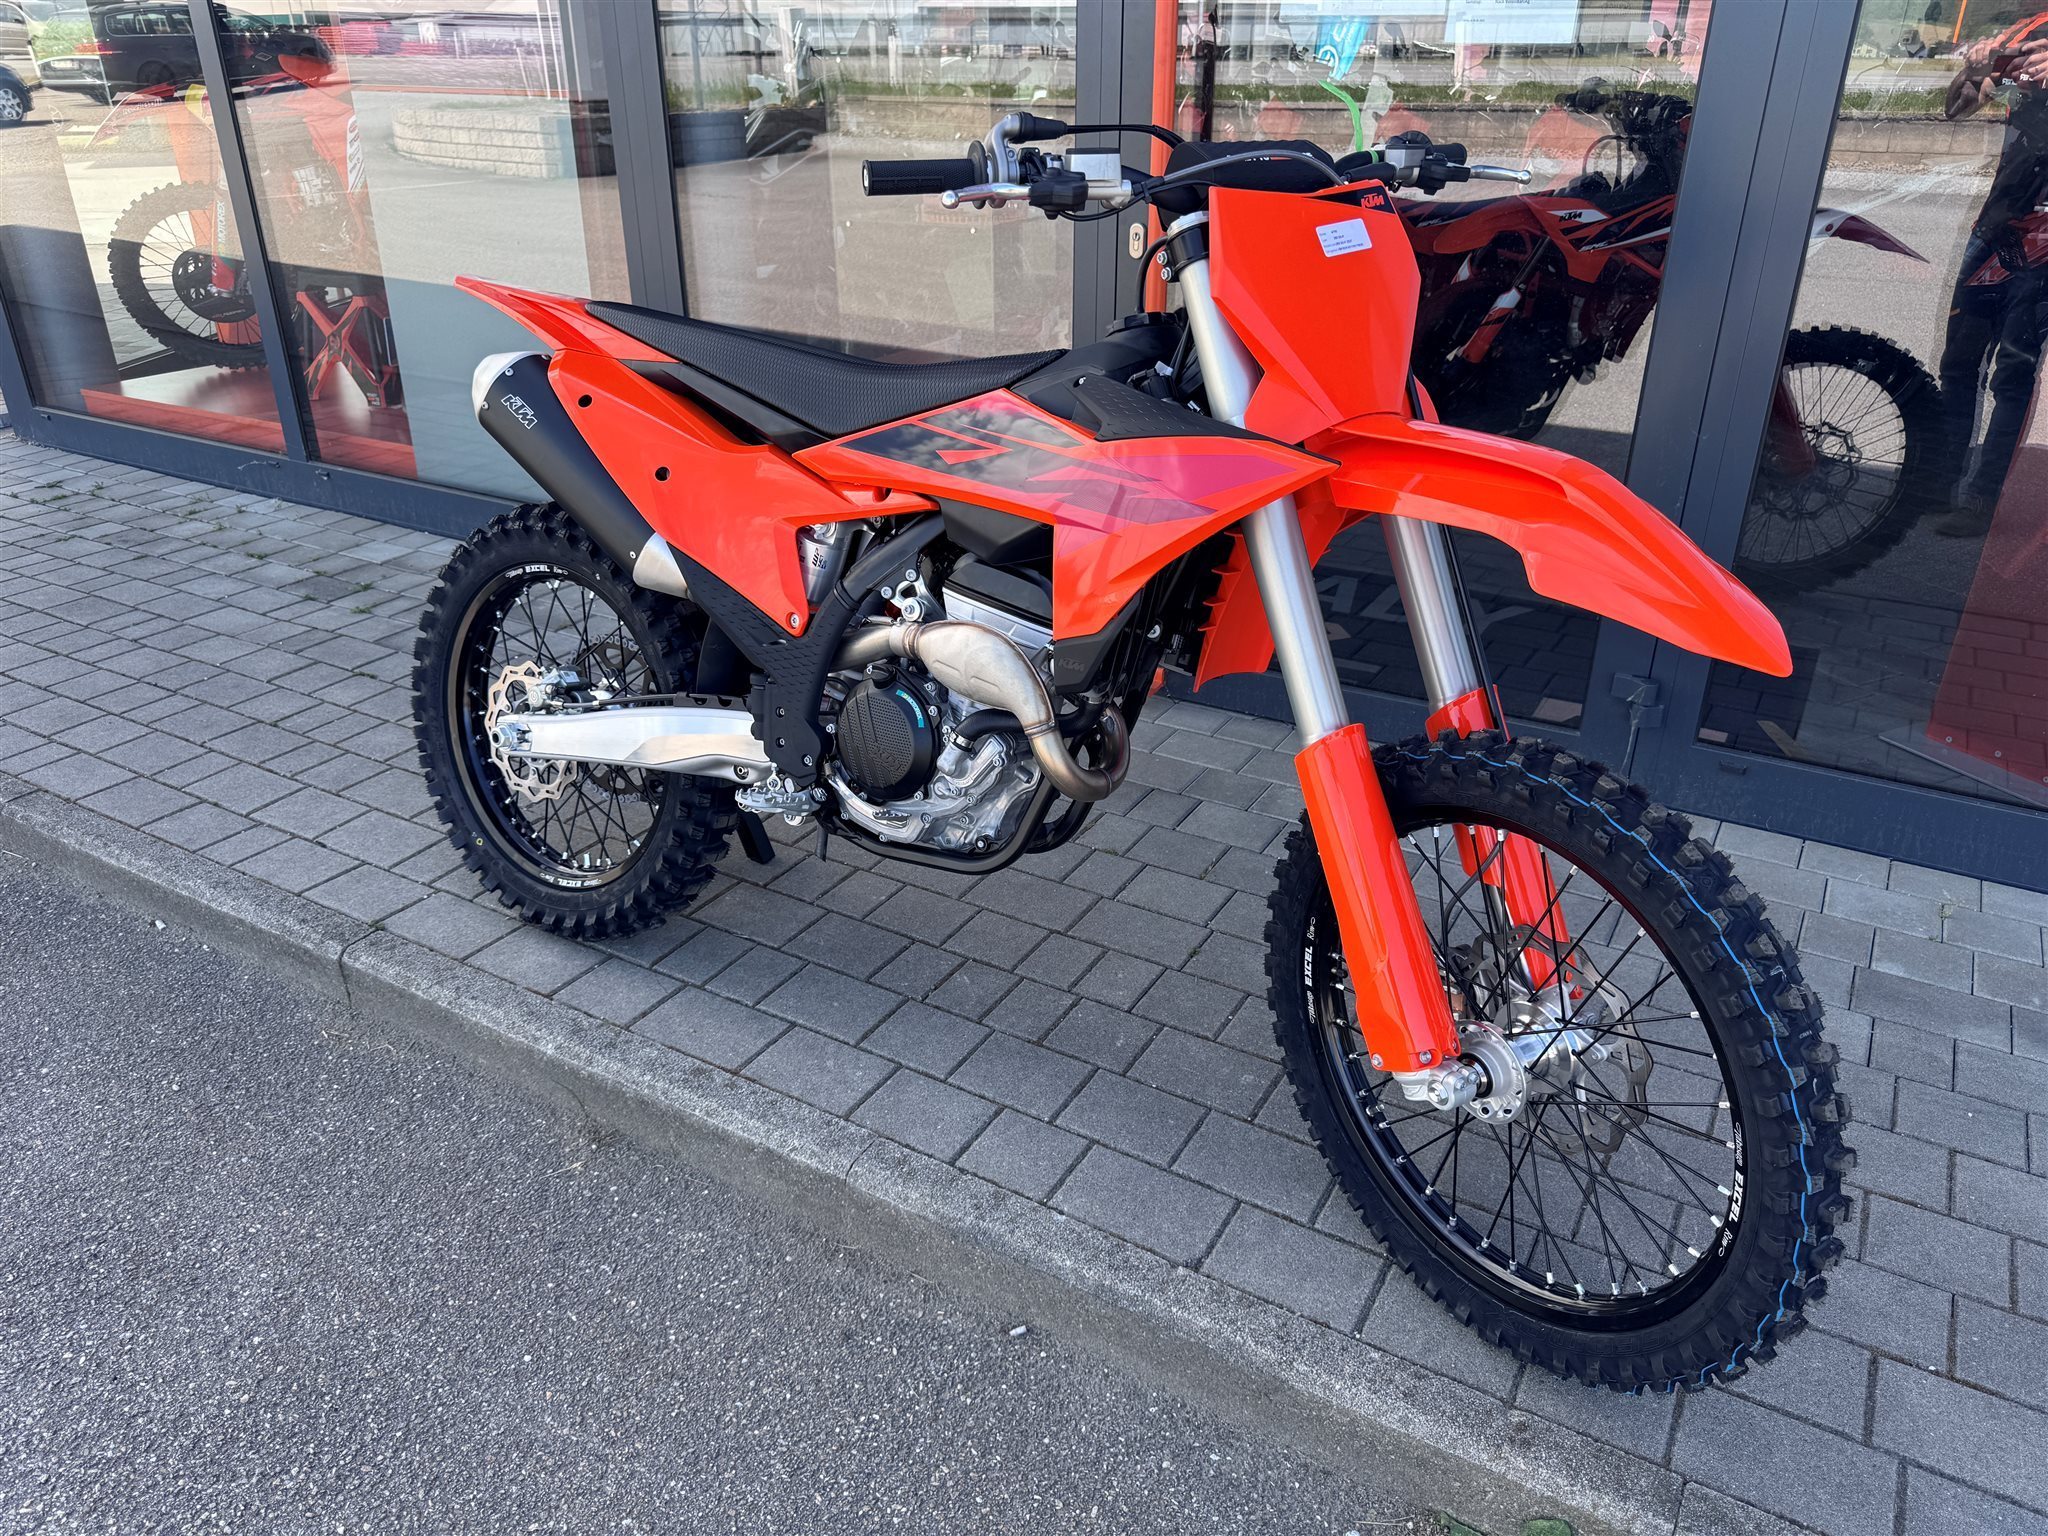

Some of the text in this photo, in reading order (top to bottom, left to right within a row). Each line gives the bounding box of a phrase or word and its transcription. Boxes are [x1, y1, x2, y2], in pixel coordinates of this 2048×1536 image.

[1361, 193, 1385, 209] KTM
[1559, 211, 1583, 222] KTM
[501, 394, 538, 430] KTM
[525, 564, 551, 573] EXCEL
[557, 878, 582, 888] EXCEL
[1304, 946, 1313, 987] EXCEL
[1728, 1170, 1744, 1223] EXCEL
[1718, 1227, 1733, 1257] Rim
